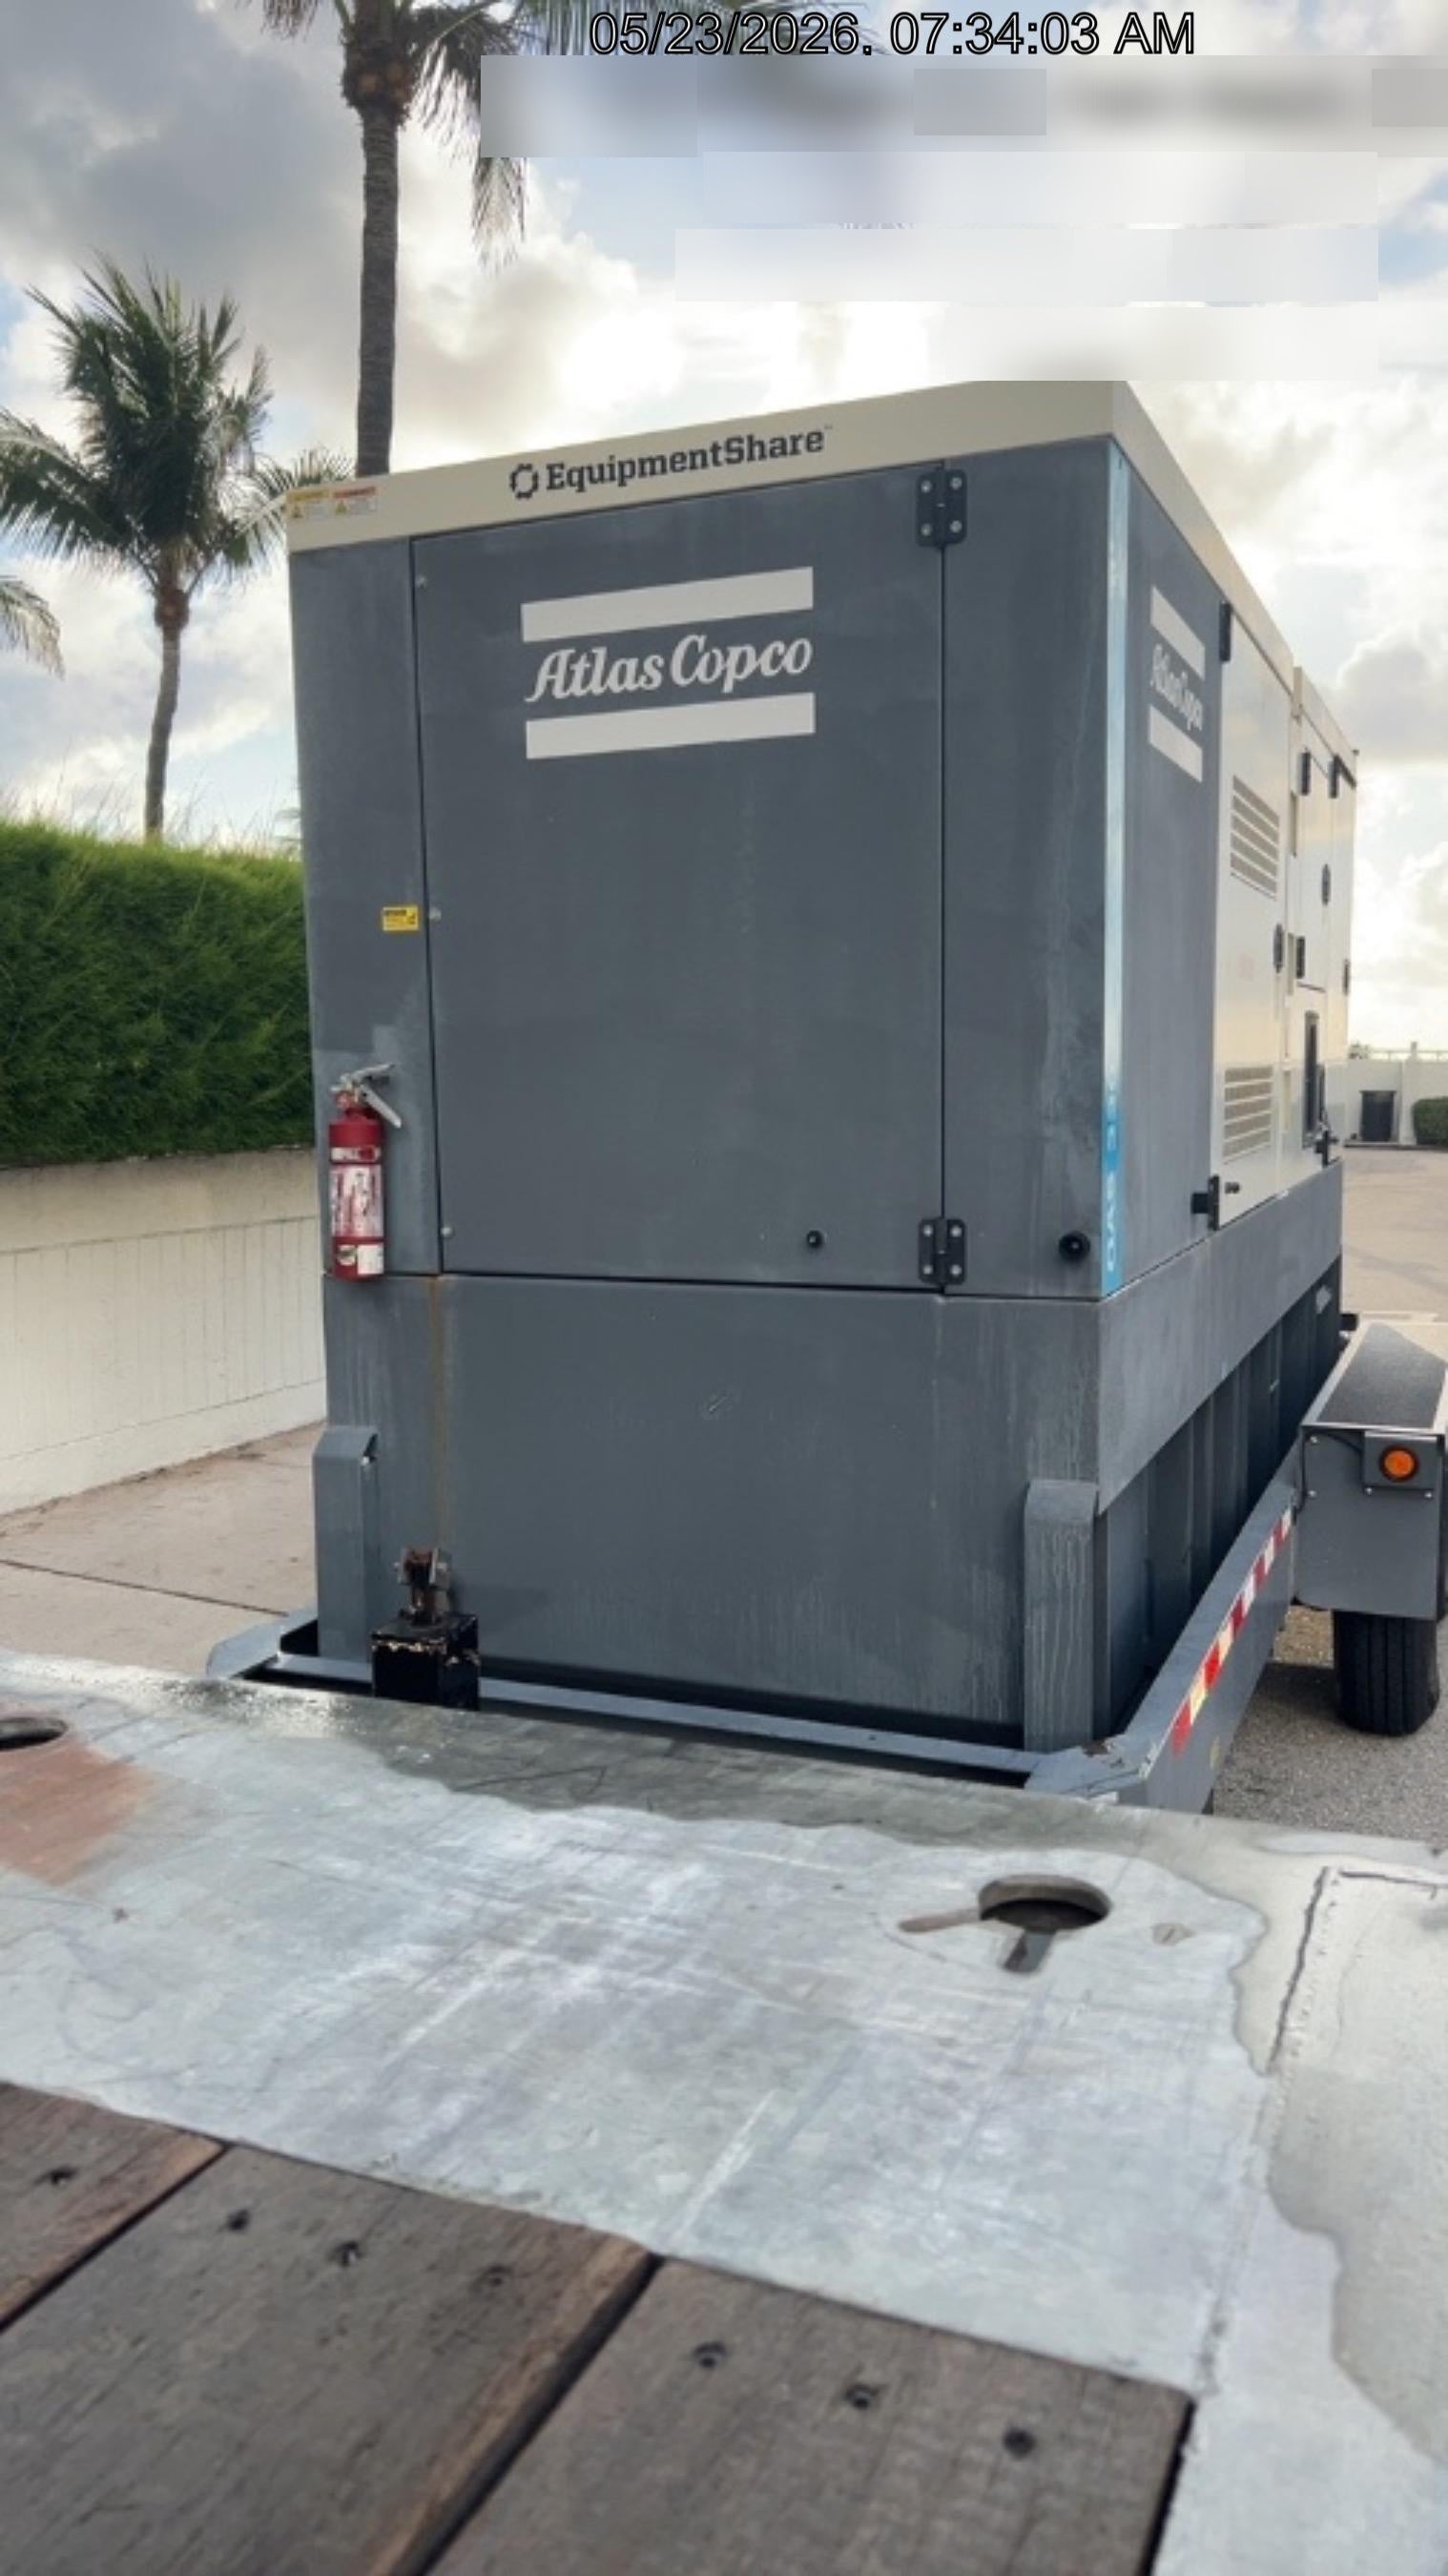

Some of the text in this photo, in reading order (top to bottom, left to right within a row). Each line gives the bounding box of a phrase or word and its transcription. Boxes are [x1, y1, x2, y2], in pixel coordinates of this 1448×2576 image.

[546, 430, 824, 493] EquipmentShare
[525, 634, 813, 703] Atlas Copco
